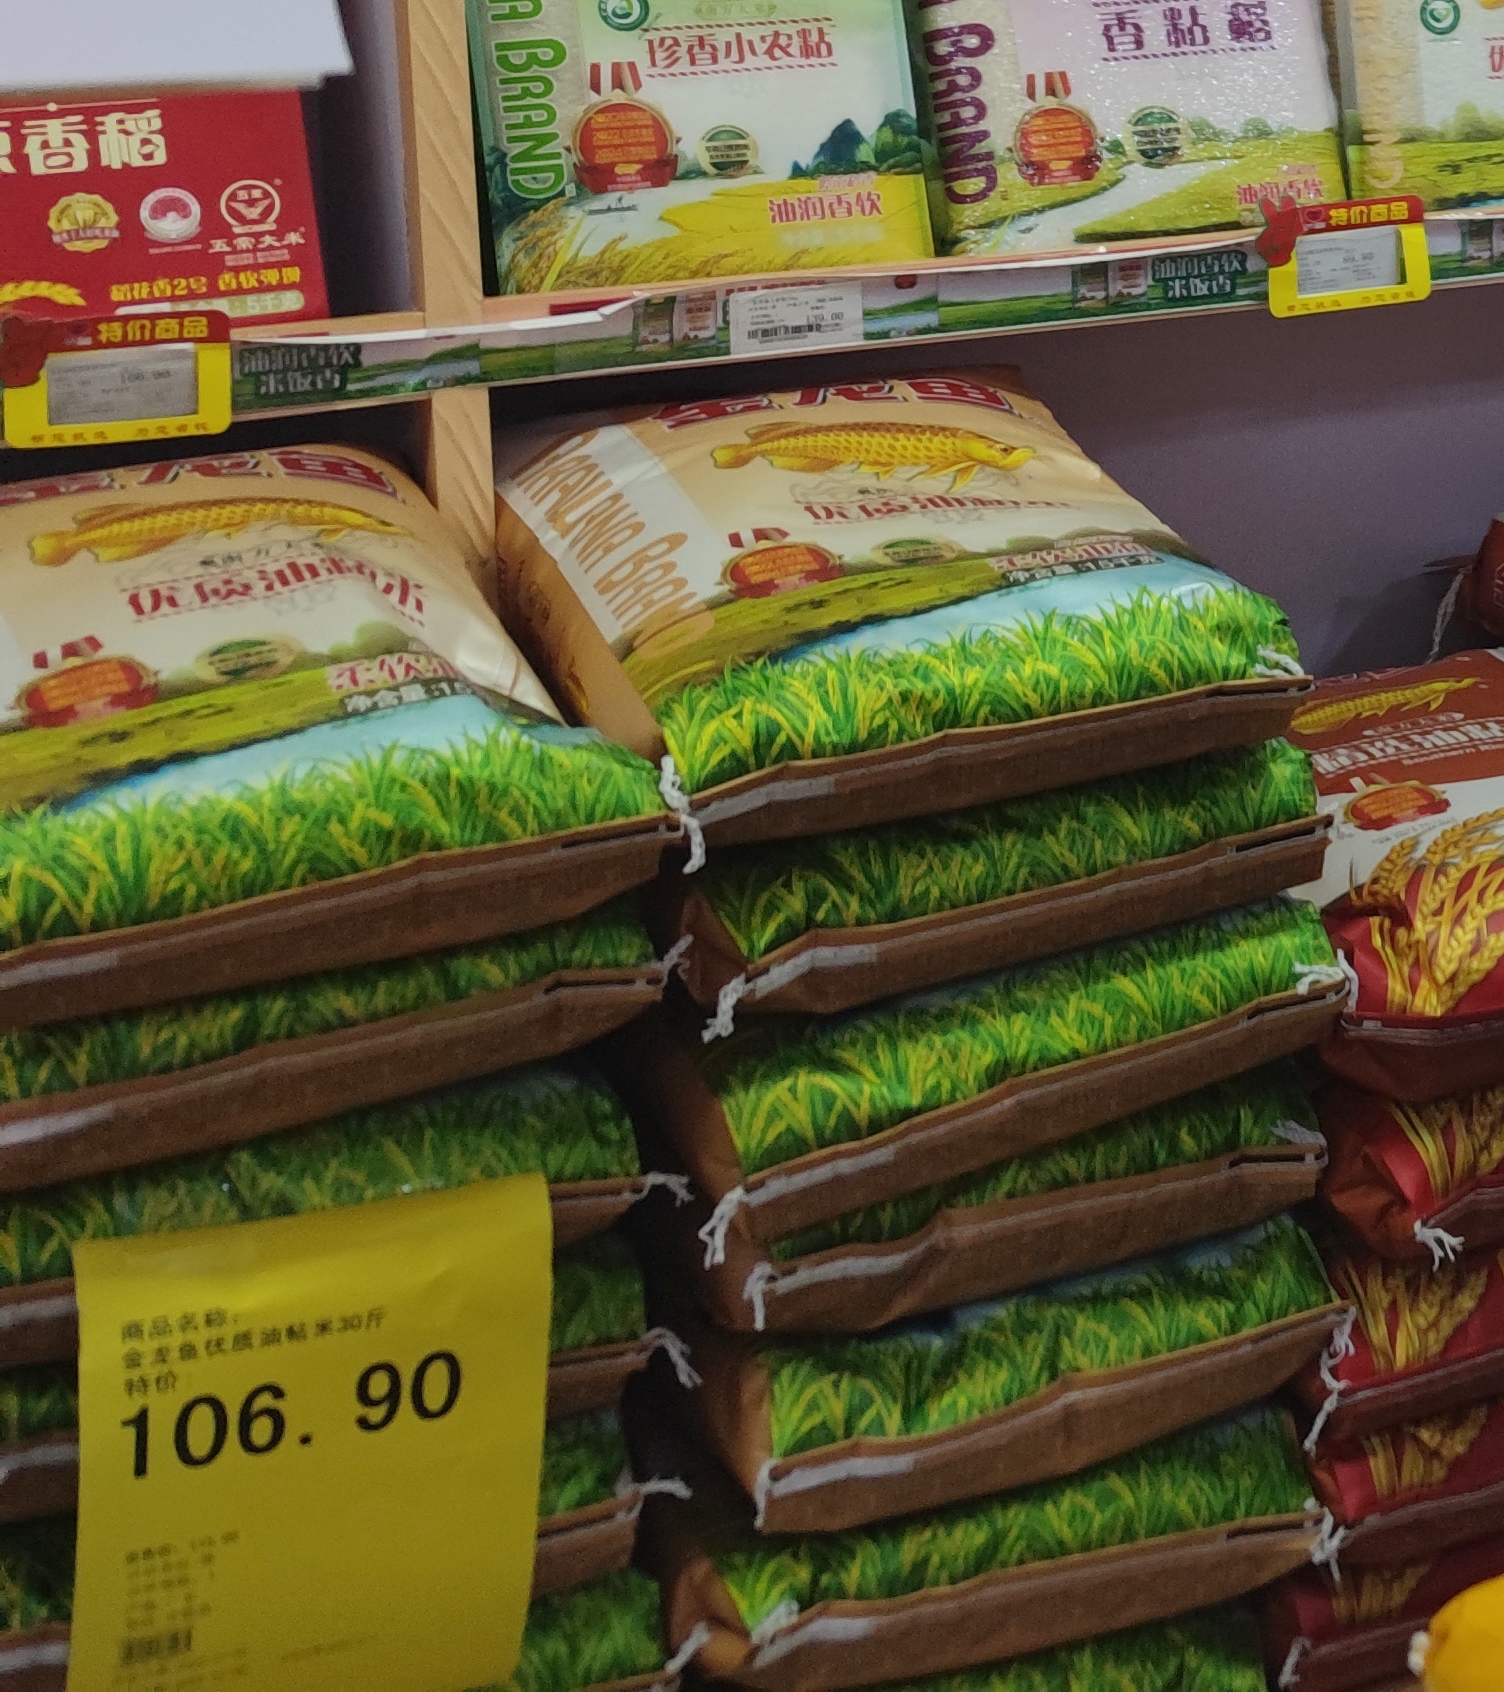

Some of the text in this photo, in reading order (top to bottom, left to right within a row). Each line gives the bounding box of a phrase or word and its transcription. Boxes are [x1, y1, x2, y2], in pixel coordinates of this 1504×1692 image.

[645, 25, 836, 71] 珍香小农粘
[495, 36, 570, 202] BRAND
[922, 20, 1000, 208] BRAND
[768, 190, 884, 225] 油润香软
[97, 315, 209, 345] 特价商品
[120, 1349, 463, 1480] 106.90
